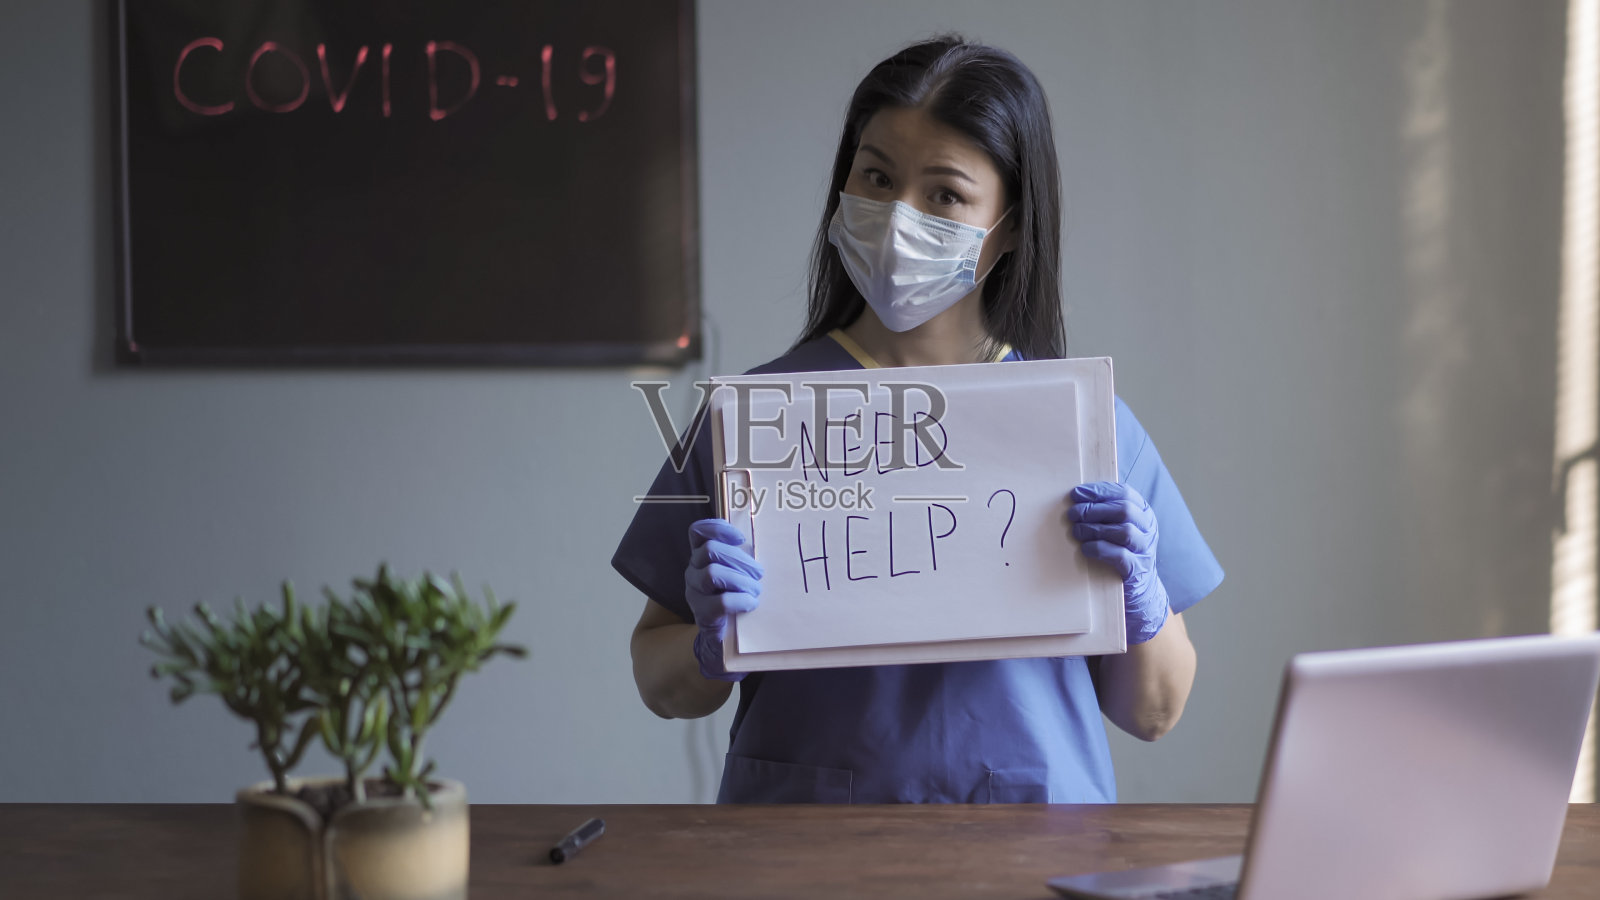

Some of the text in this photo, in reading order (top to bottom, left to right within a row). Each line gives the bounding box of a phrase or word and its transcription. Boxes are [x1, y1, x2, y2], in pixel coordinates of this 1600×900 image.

[173, 37, 617, 121] COVID-19
[800, 411, 948, 482] NEED
[798, 503, 957, 593] HELP
